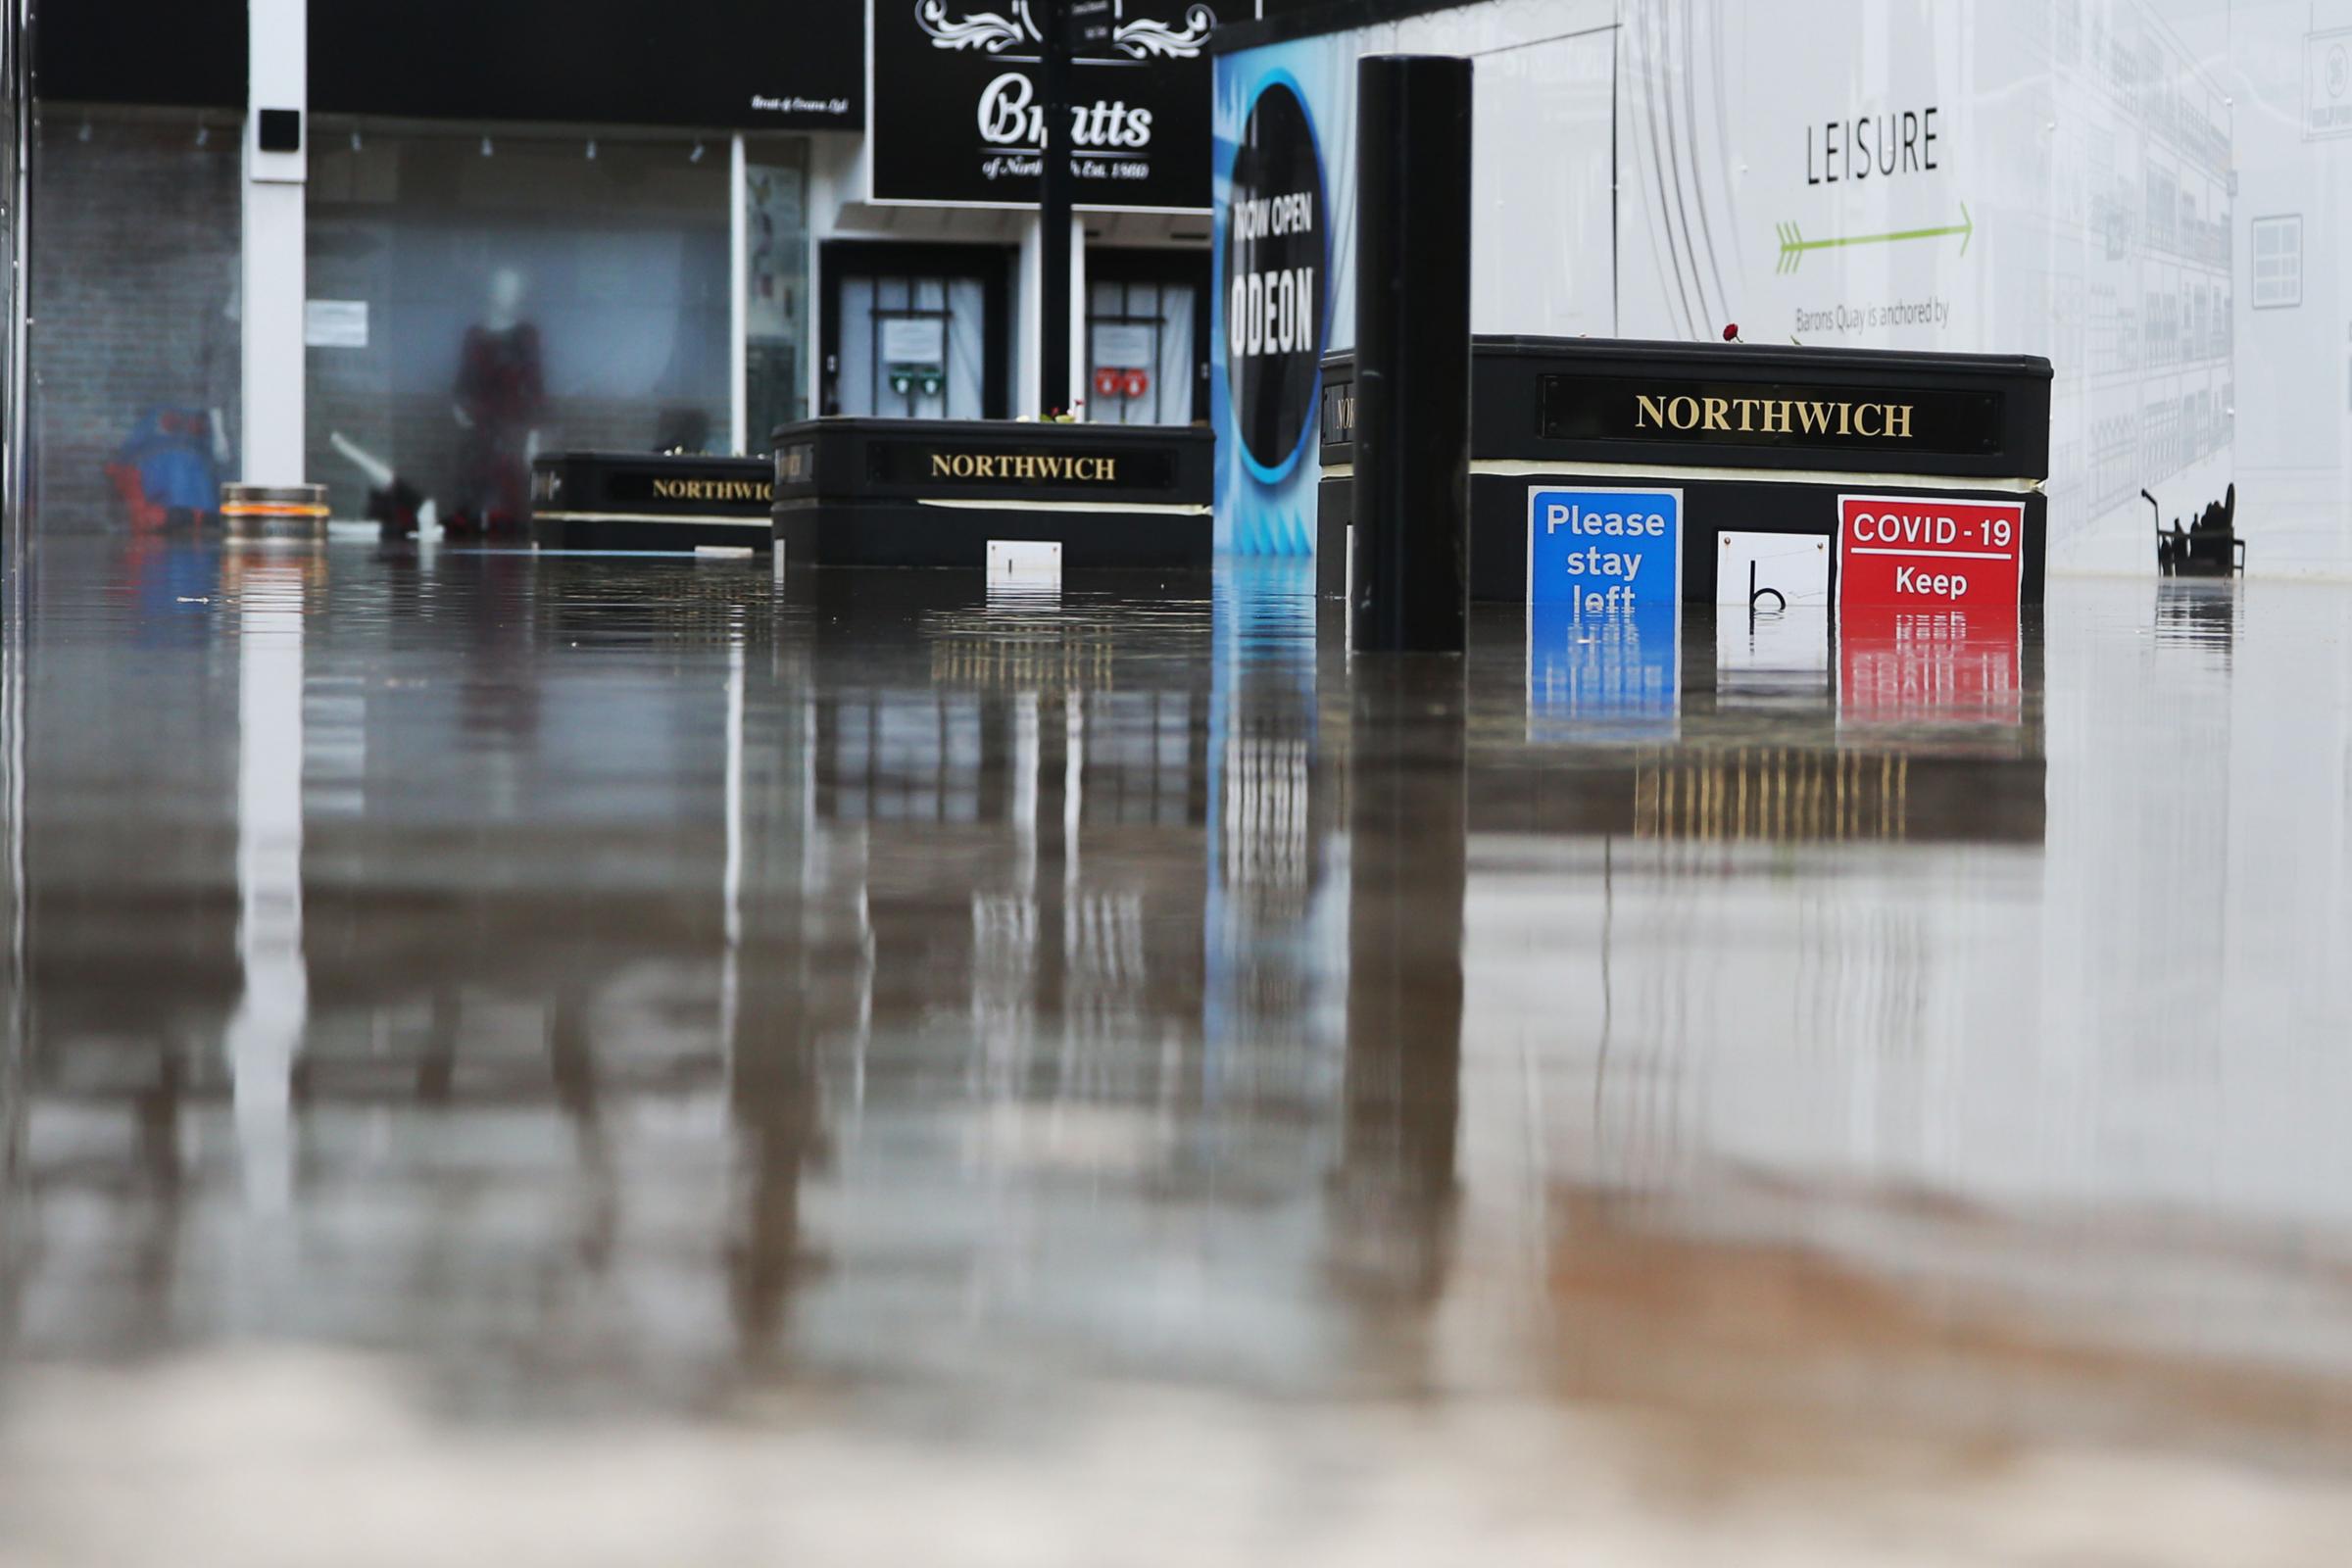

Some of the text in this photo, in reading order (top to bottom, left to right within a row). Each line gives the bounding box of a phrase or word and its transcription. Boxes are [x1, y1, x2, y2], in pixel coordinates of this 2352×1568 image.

[1807, 108, 1937, 184] LEISURE
[1234, 192, 1312, 241] NOW OPEN
[1231, 267, 1313, 357] ODEON
[1796, 296, 1950, 335] Barons Quay is anchored by
[1636, 395, 1913, 438] NORTHWICH
[931, 454, 1116, 480] NORTHWICH
[653, 479, 773, 502] NORTHWIC
[1547, 505, 1665, 536] Please
[1567, 546, 1642, 581] stay
[1573, 584, 1636, 608] left
[1895, 565, 1968, 600] Keep
